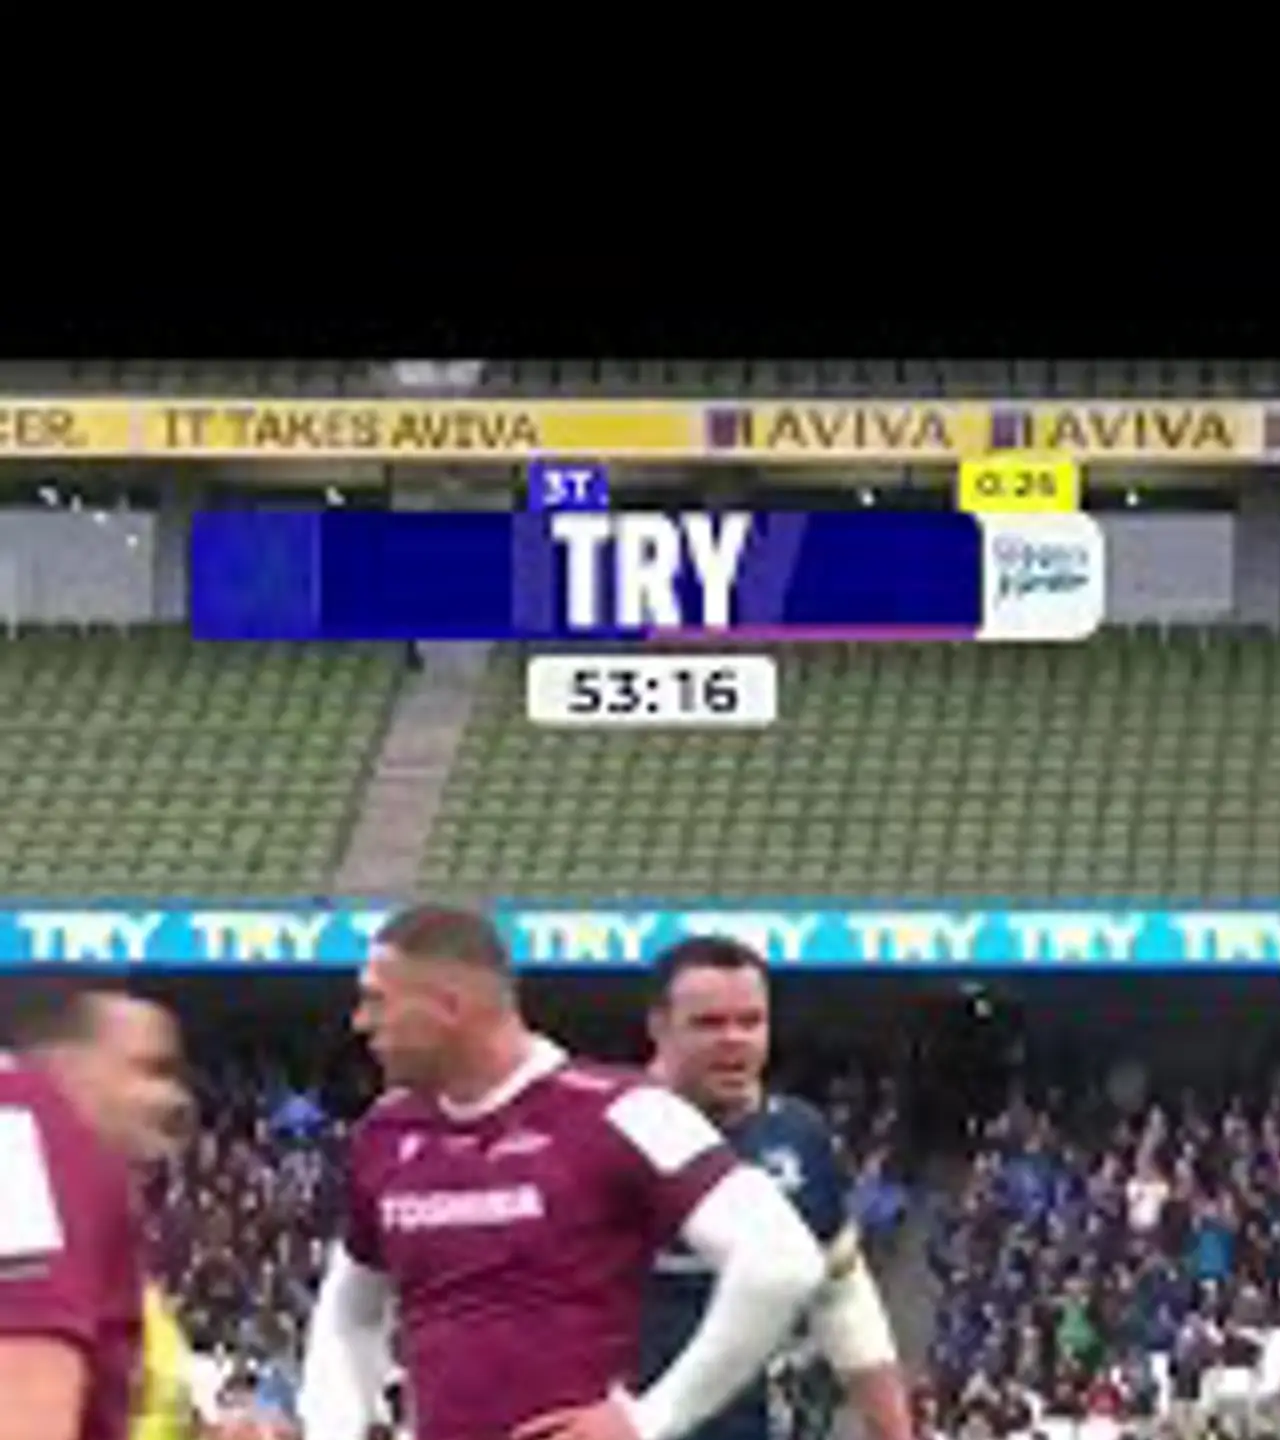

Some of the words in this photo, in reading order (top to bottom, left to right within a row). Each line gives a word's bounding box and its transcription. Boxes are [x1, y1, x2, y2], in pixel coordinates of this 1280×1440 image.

[165, 408, 210, 448] IT
[230, 407, 380, 448] TAKES
[390, 408, 538, 449] AVIVA
[766, 409, 953, 448] AVIVA
[1046, 410, 1236, 449] AVIVA
[17, 912, 166, 962] TRY
[192, 912, 330, 962] TRY
[515, 912, 656, 962] TRY
[845, 911, 986, 962] TRY
[1009, 911, 1142, 962] TRY
